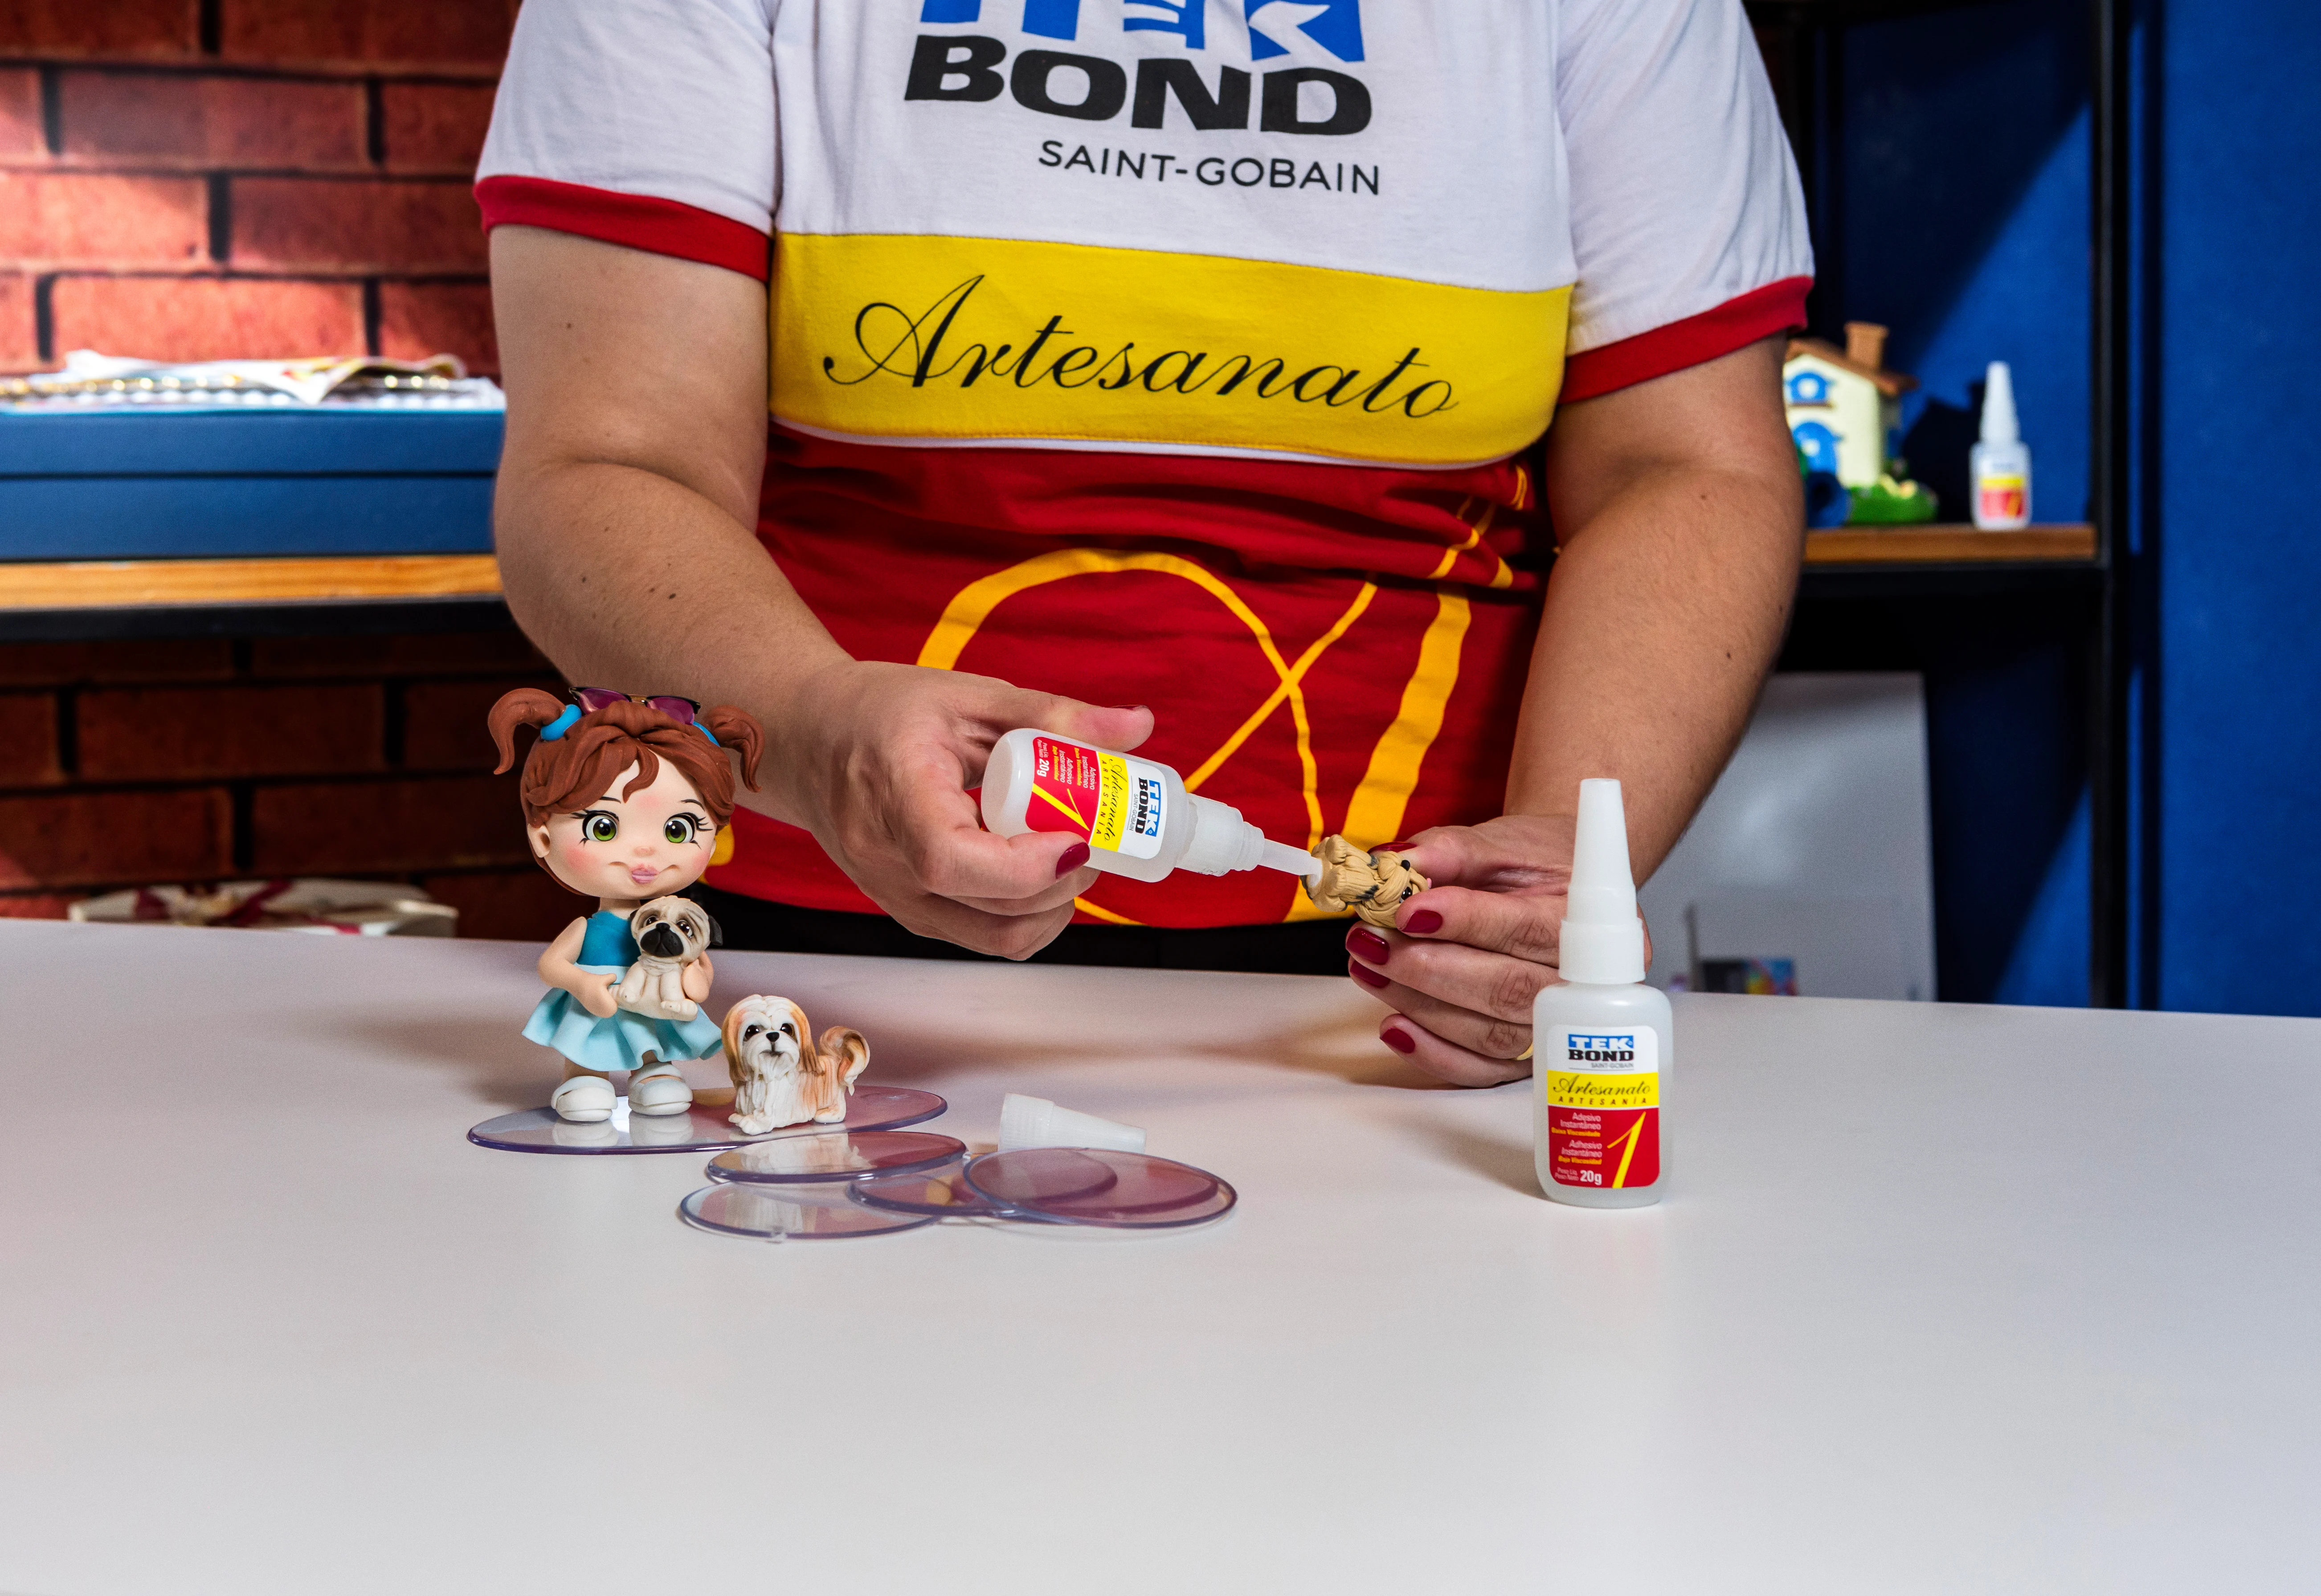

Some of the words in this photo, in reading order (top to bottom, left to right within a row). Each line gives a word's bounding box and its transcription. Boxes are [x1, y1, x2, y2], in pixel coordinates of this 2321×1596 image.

[904, 35, 1372, 135] BOND
[1038, 140, 1379, 195] SAINT-GOBAIN
[822, 274, 1459, 418] Artesanato
[1037, 758, 1050, 777] 20g
[1096, 760, 1109, 835] ARTESANÍA
[1104, 759, 1128, 841] Artesanato
[1129, 793, 1138, 831] SAINT-GOBAIN
[1135, 777, 1148, 834] BOND
[1145, 780, 1161, 837] TEK
[1568, 1034, 1634, 1049] TEK
[1568, 1049, 1634, 1061] BOND
[1553, 1075, 1651, 1095] Artesanato
[1580, 1170, 1602, 1185] 20g
[1607, 1111, 1646, 1188] 1
